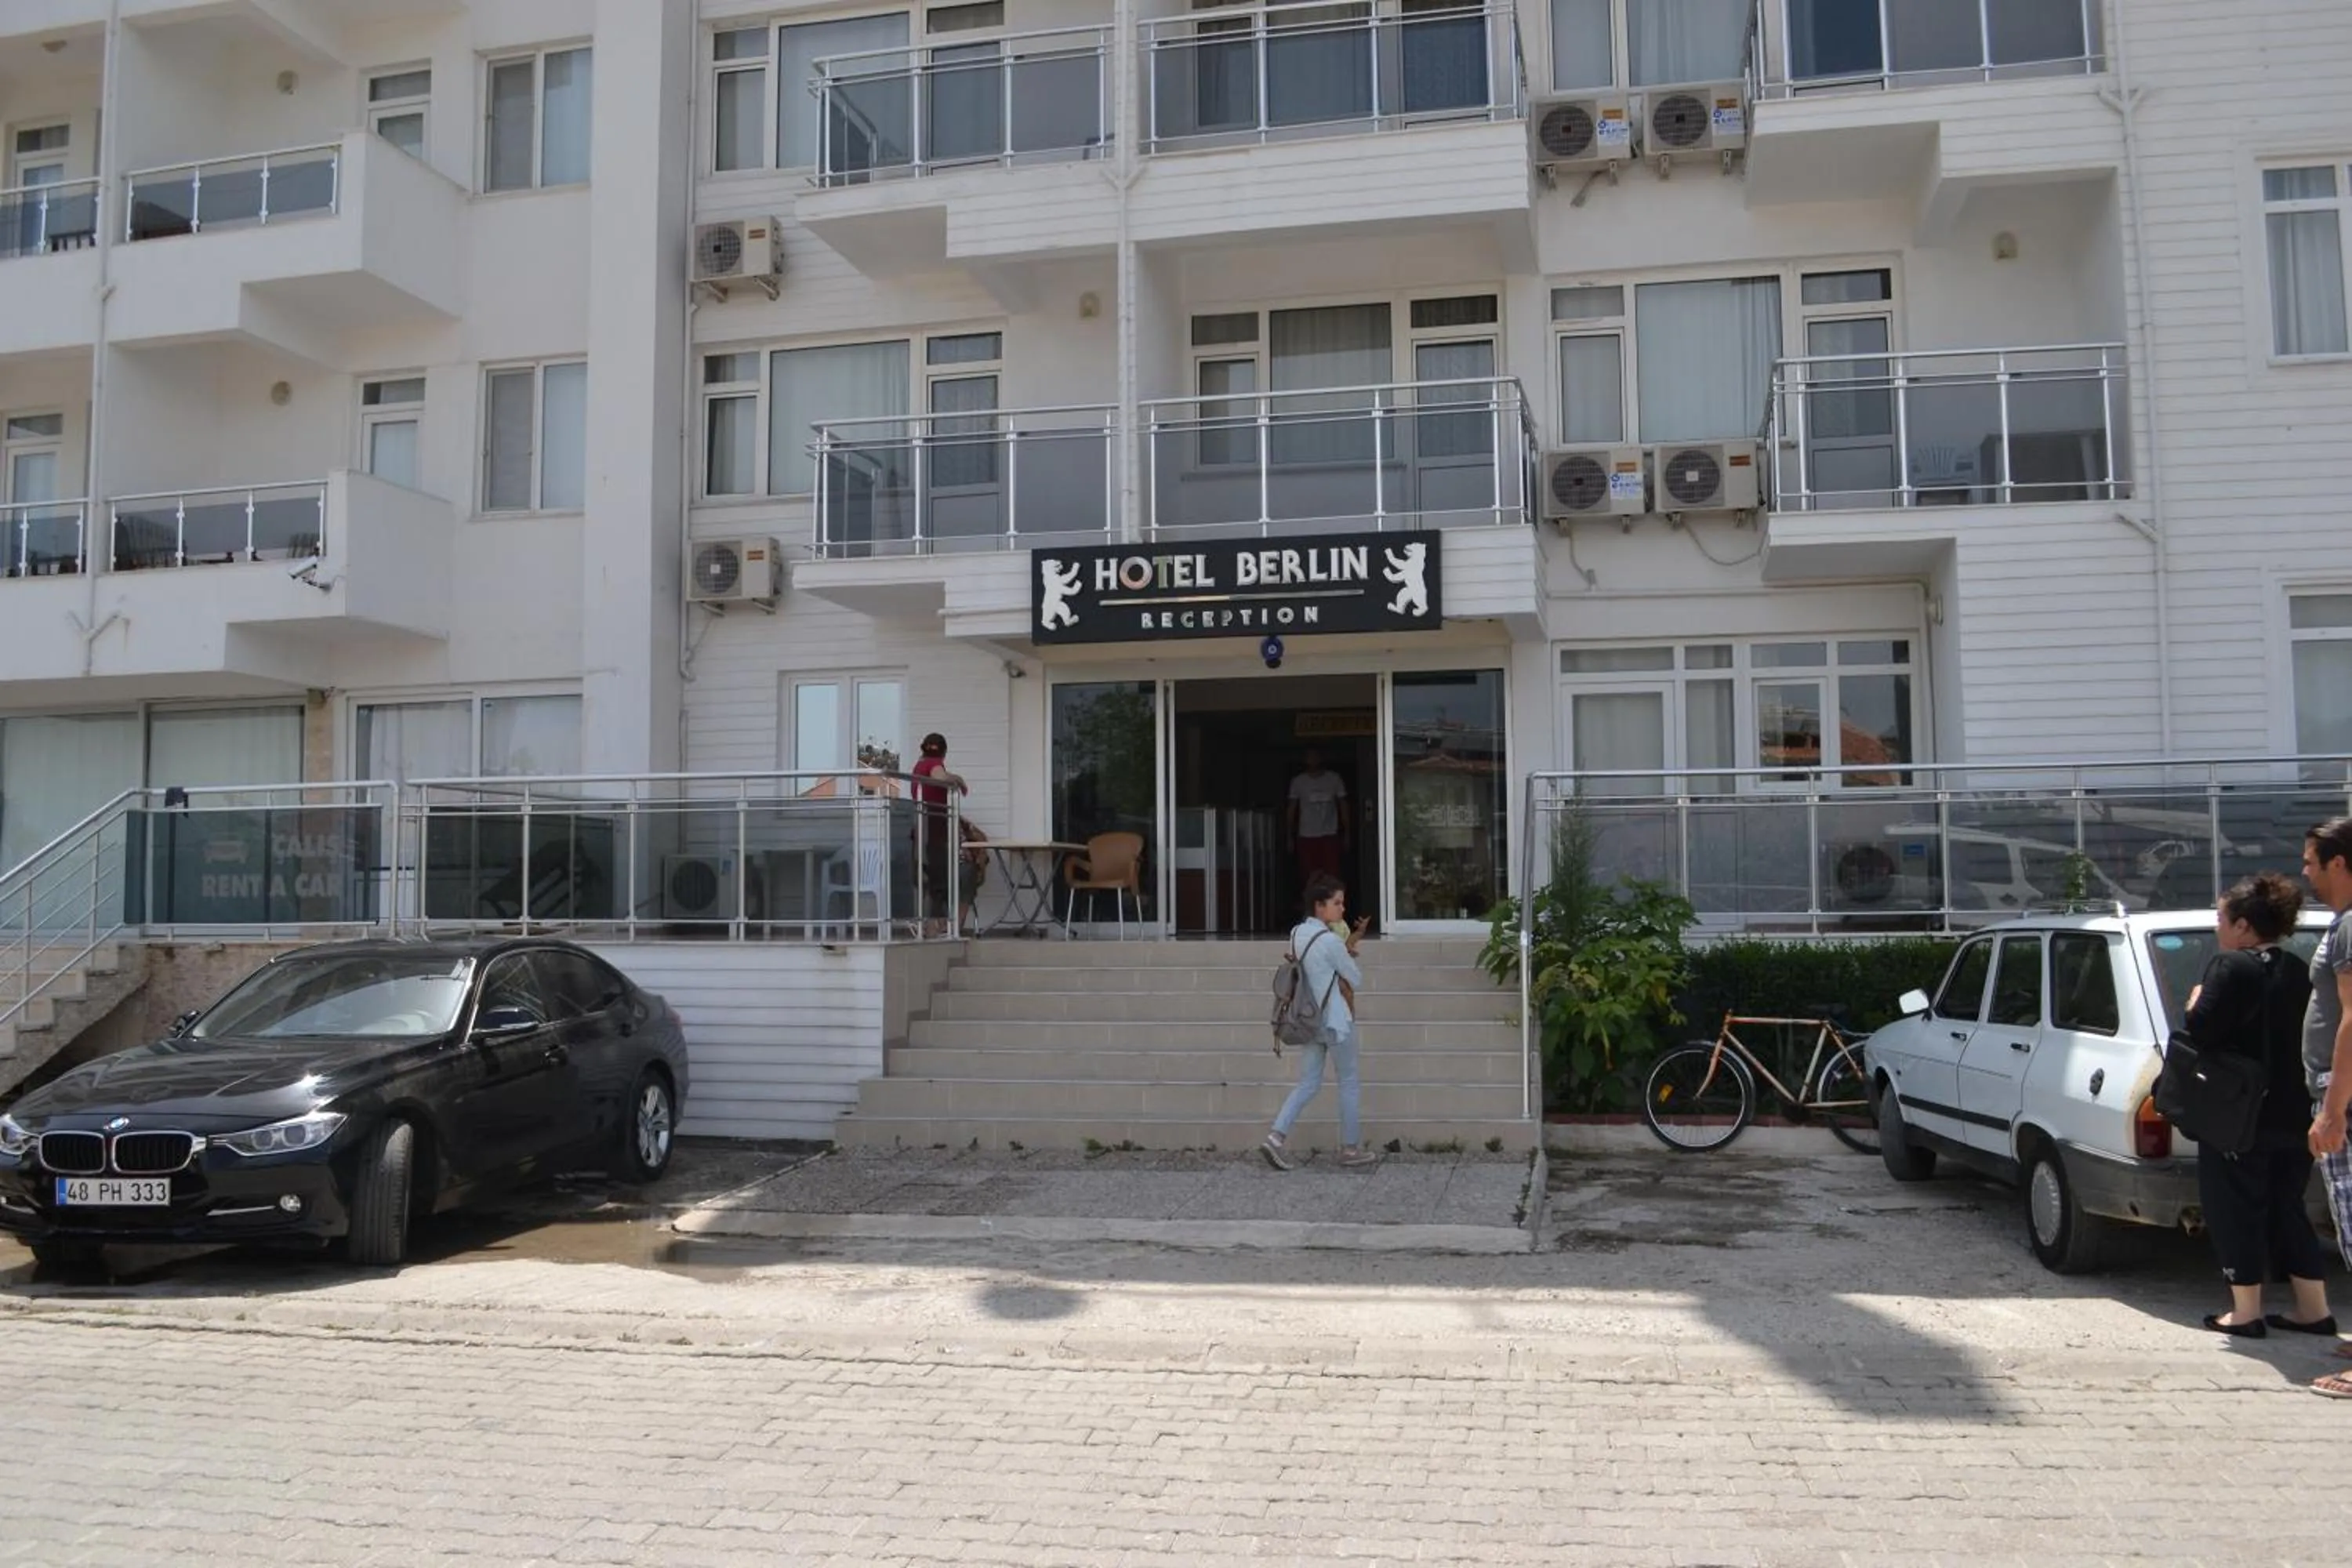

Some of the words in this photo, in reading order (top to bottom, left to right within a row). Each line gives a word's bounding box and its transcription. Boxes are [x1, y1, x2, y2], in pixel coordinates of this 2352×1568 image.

[1095, 554, 1215, 590] HOTEL
[1236, 546, 1370, 586] BERLIN
[1141, 606, 1319, 628] RECEPTION
[201, 874, 263, 898] RENT
[270, 874, 286, 897] A
[295, 873, 342, 897] CAR
[67, 1181, 89, 1201] 48
[99, 1182, 122, 1201] PH
[130, 1182, 167, 1201] 333
